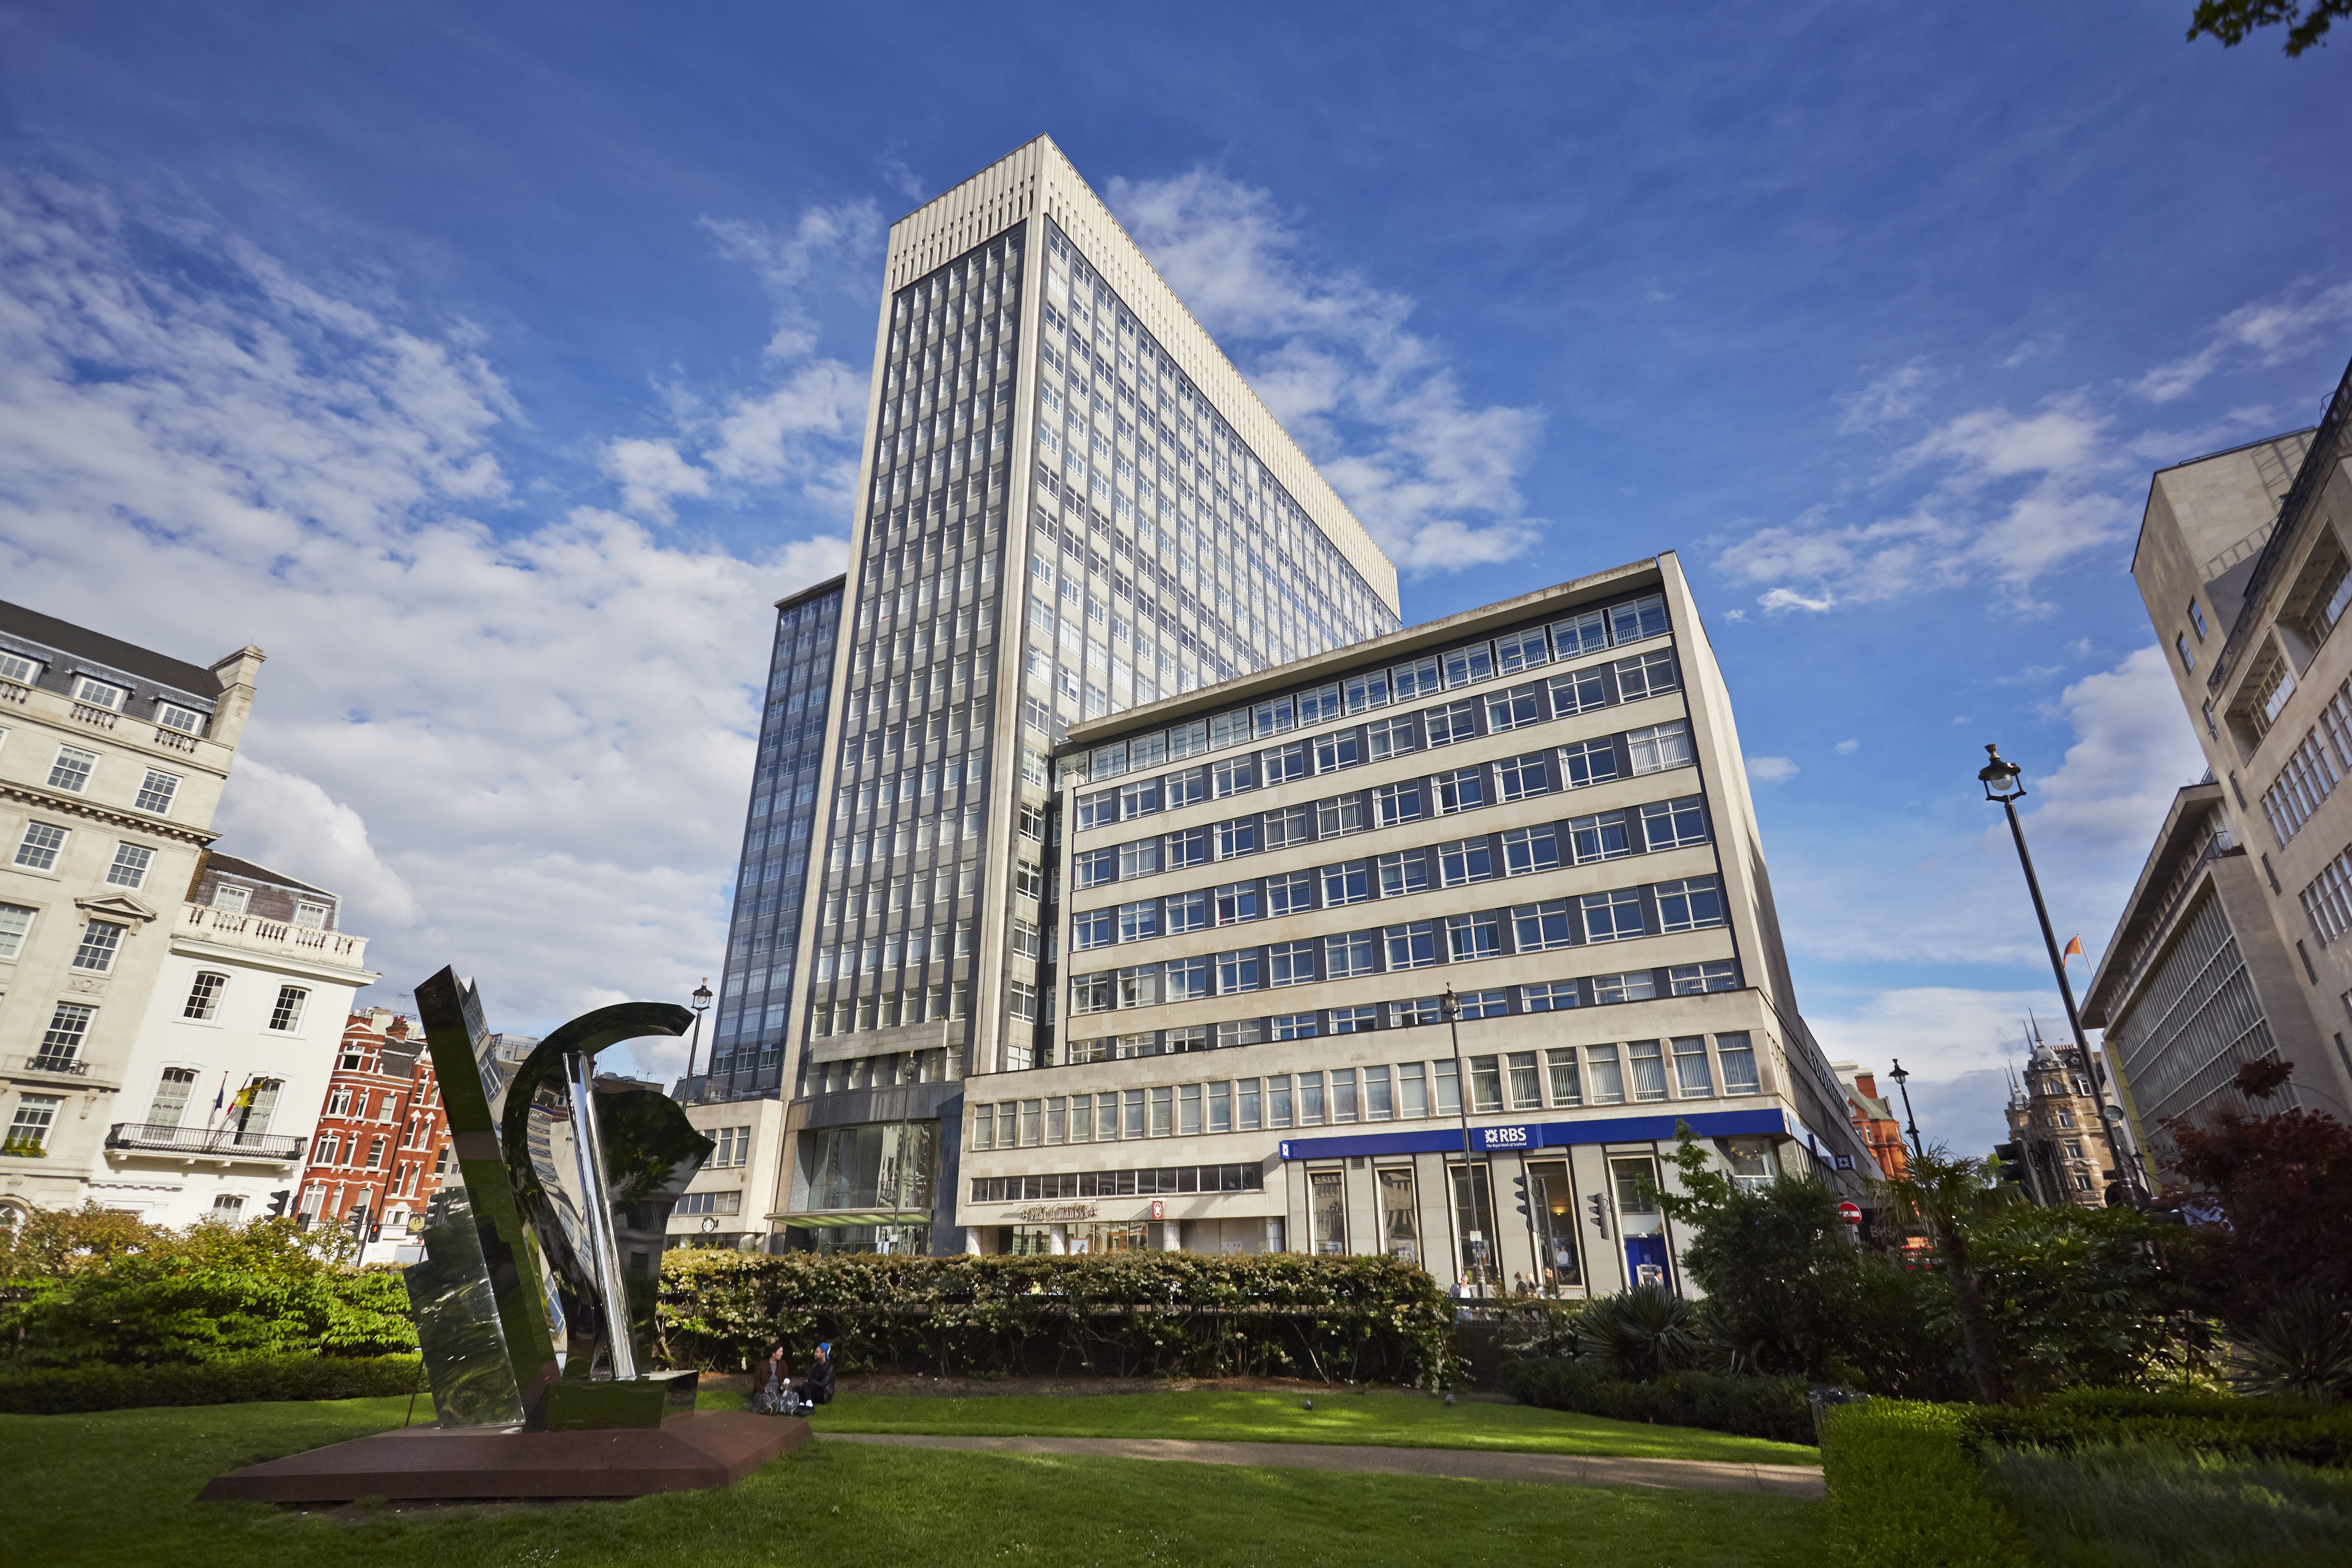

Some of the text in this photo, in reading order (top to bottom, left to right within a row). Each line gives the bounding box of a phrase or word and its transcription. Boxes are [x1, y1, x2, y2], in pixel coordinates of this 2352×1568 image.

[1499, 1127, 1526, 1142] RBS
[1031, 1204, 1089, 1220] PRET A MANGER
